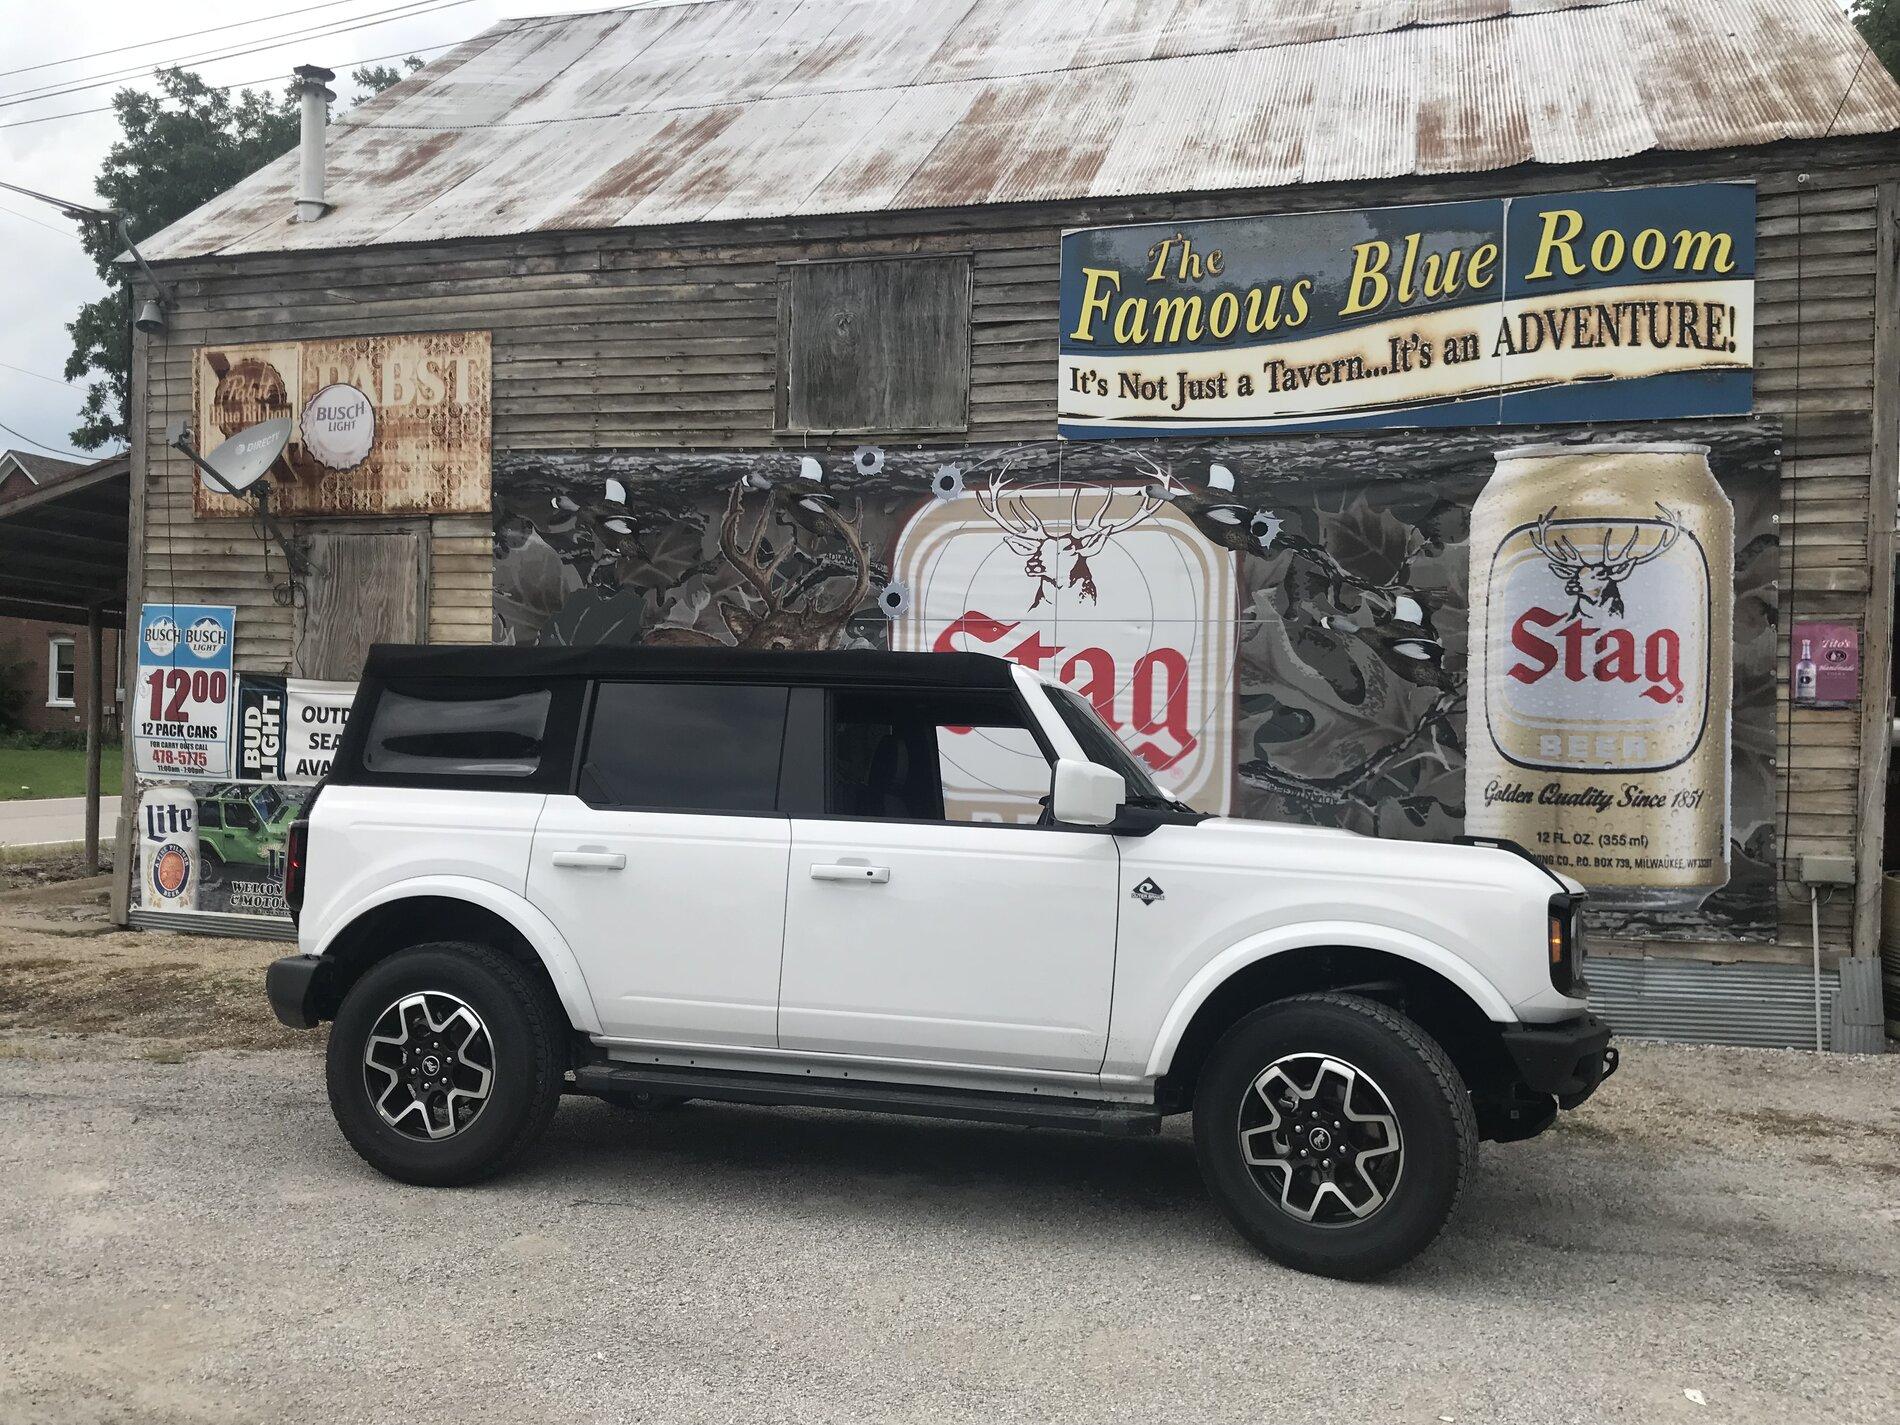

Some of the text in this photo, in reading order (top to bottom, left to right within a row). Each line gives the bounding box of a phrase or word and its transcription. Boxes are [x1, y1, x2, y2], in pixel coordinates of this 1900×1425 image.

[1147, 232, 1225, 282] The
[1070, 209, 1736, 343] Famous Blue Room
[1069, 366, 1108, 396] It's
[1118, 372, 1168, 401] Not
[1171, 371, 1229, 411] Just
[1237, 374, 1254, 397] a
[1443, 333, 1480, 365] an
[1493, 302, 1737, 356] ADVENTURE!
[316, 355, 481, 407] PABST
[316, 401, 365, 421] BUSCH
[328, 420, 357, 432] LIGHT
[145, 628, 181, 642] BUSCH
[186, 630, 226, 644] BUSCH
[1822, 640, 1851, 648] Tito's
[1507, 606, 1684, 704] Stag
[142, 723, 217, 739] 12 PACK CANS
[244, 707, 261, 768] BUD
[261, 695, 280, 780] LIGHT
[161, 741, 178, 749] CARRY
[195, 743, 208, 751] CALL
[1540, 735, 1647, 758] BEER
[153, 749, 207, 767] 478-5775
[1485, 780, 1704, 812] Golden Quality Since 1851
[146, 803, 193, 842] Lite
[1537, 832, 1549, 843] 12
[1553, 833, 1570, 845] FL.
[1573, 834, 1594, 846] OZ.
[1599, 834, 1627, 848] (355
[1594, 857, 1613, 868] BOX
